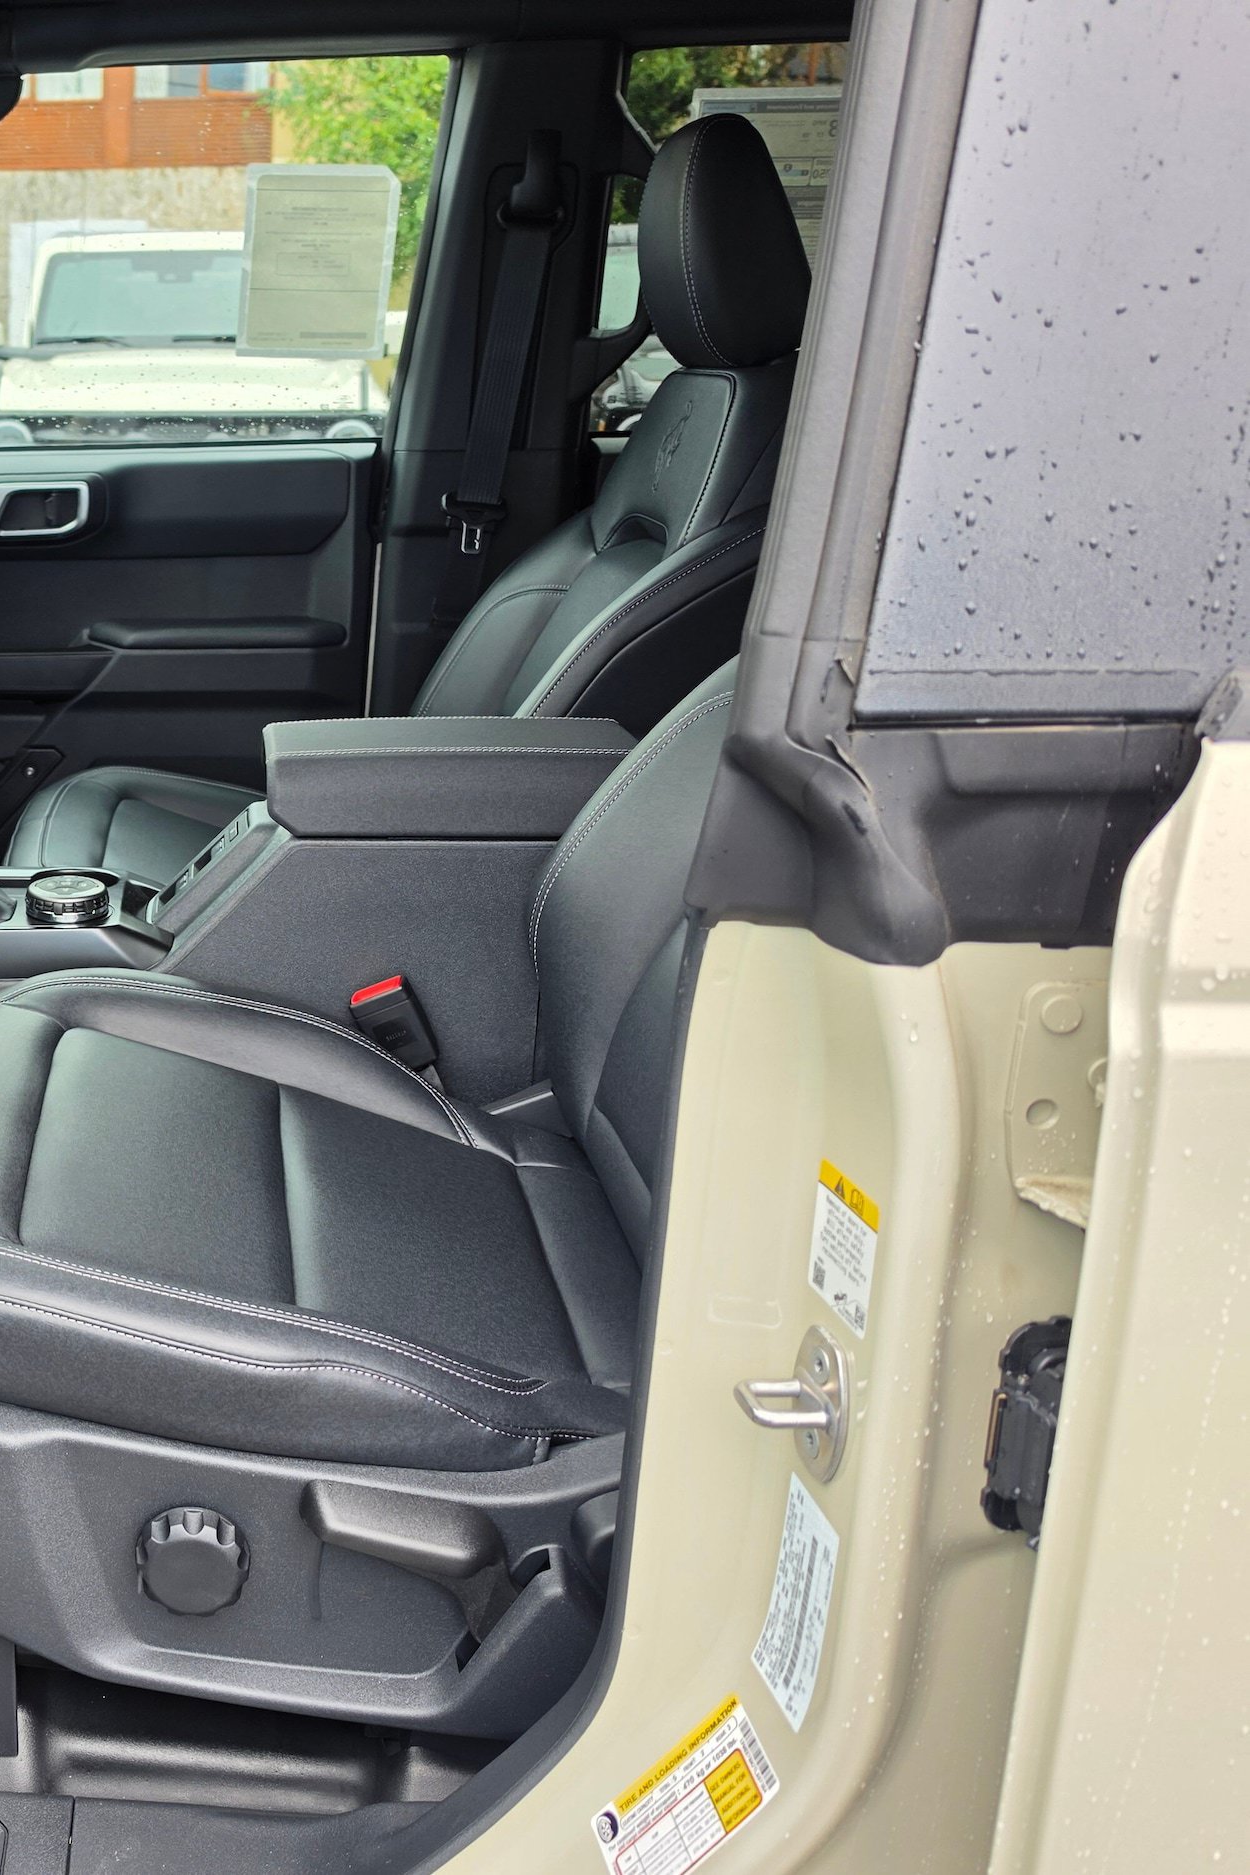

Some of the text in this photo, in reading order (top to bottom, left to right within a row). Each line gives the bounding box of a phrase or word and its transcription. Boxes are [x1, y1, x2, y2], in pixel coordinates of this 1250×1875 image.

[619, 1698, 738, 1812] TIRE AND LOADING INFORMATION
